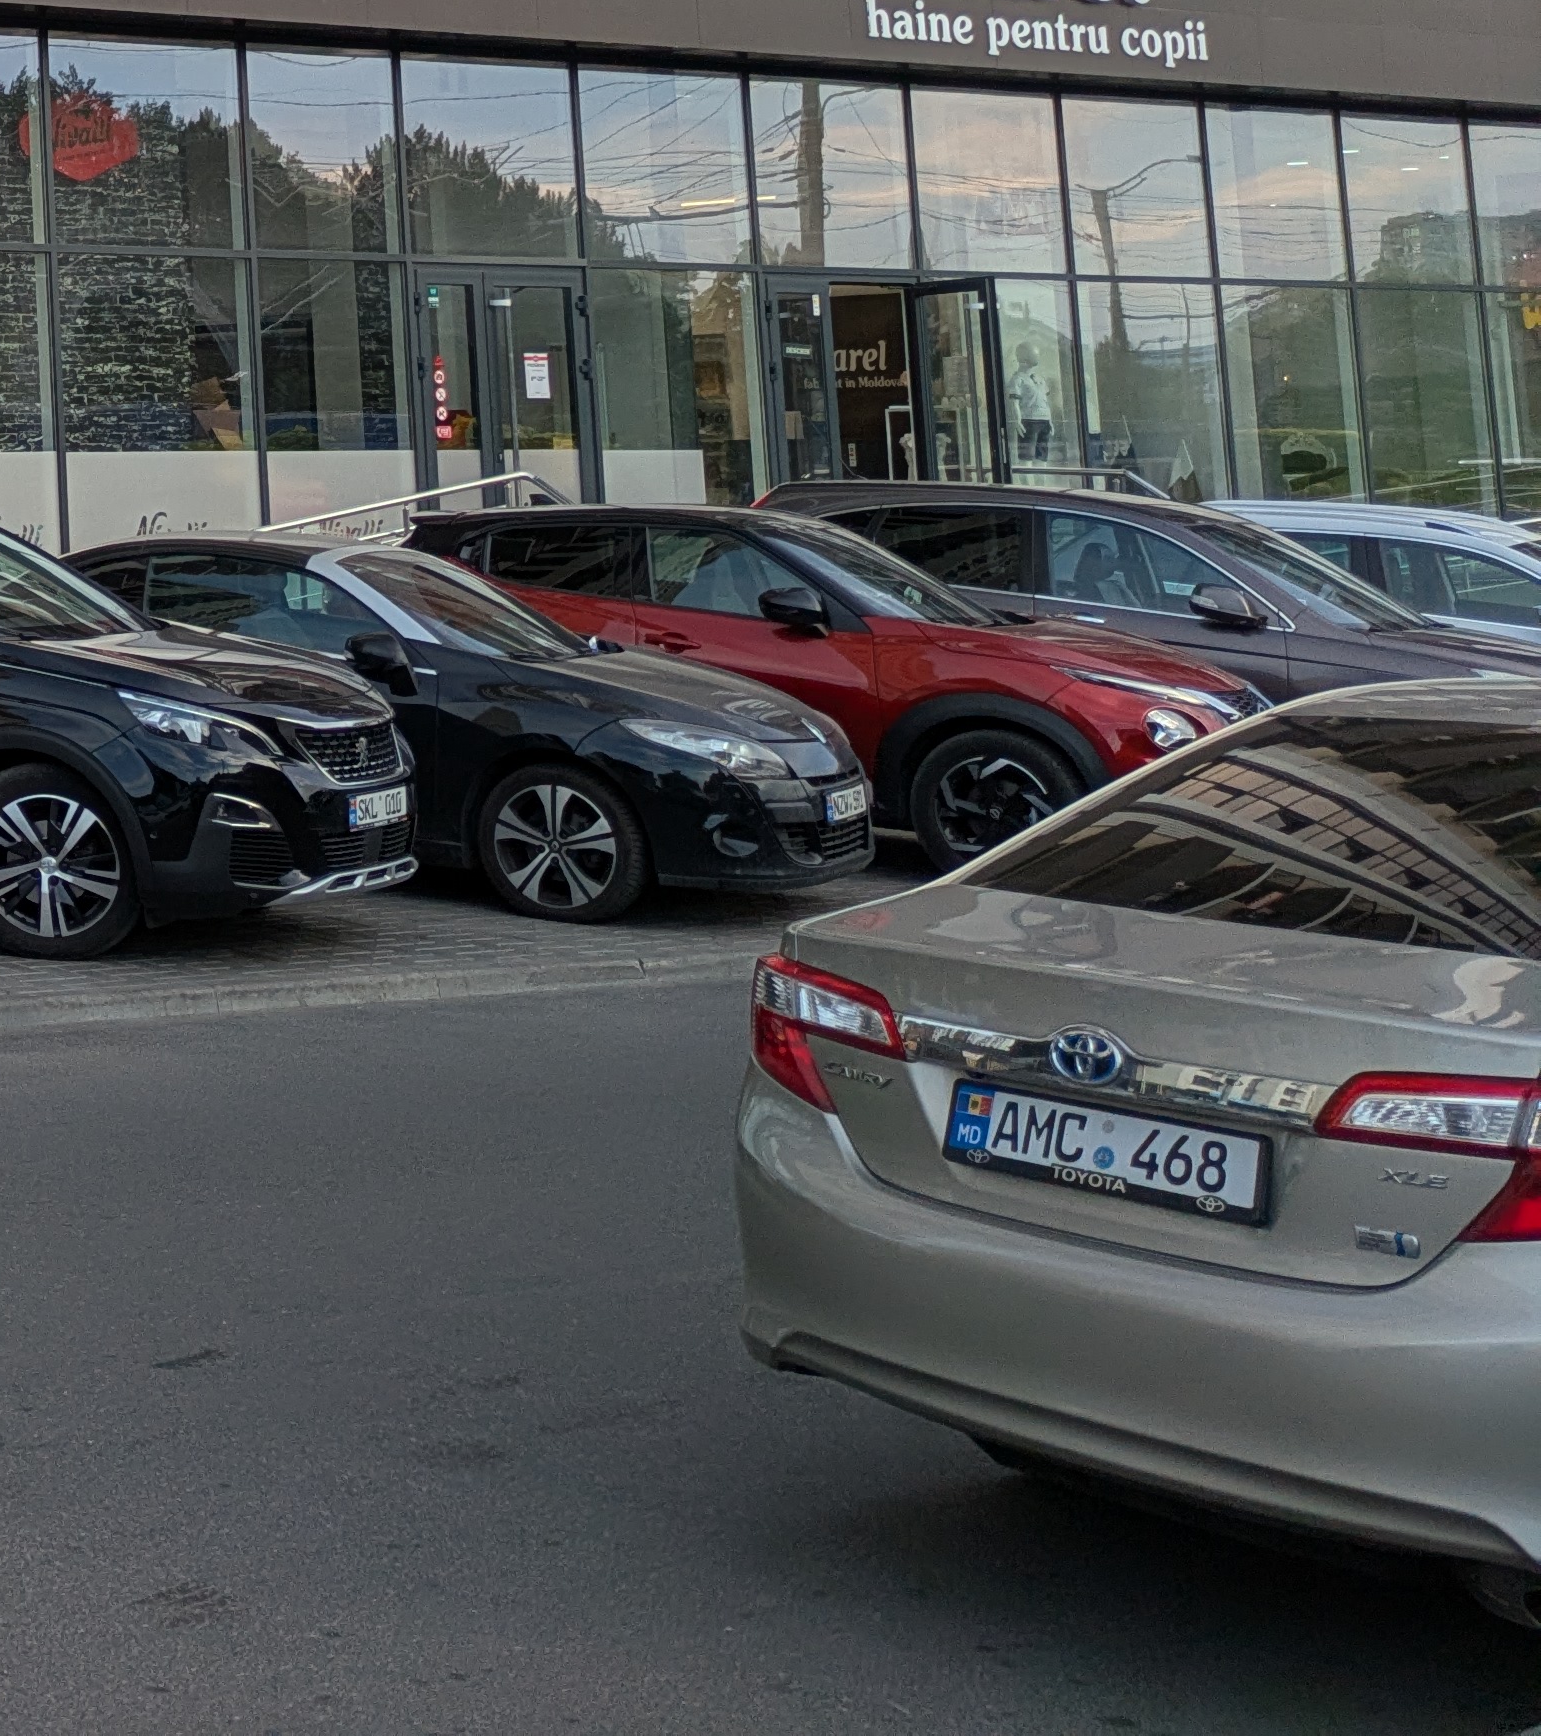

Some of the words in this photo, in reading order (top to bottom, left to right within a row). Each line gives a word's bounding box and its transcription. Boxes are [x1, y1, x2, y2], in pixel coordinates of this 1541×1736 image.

[988, 14, 1111, 56] pentru
[1122, 21, 1209, 68] copii
[834, 339, 887, 371] arel
[358, 797, 378, 821] SKL
[385, 791, 402, 815] 010
[957, 1123, 981, 1144] MD
[991, 1101, 1087, 1163] AMC
[1130, 1129, 1228, 1194] 468
[1051, 1164, 1127, 1194] TOYOTA
